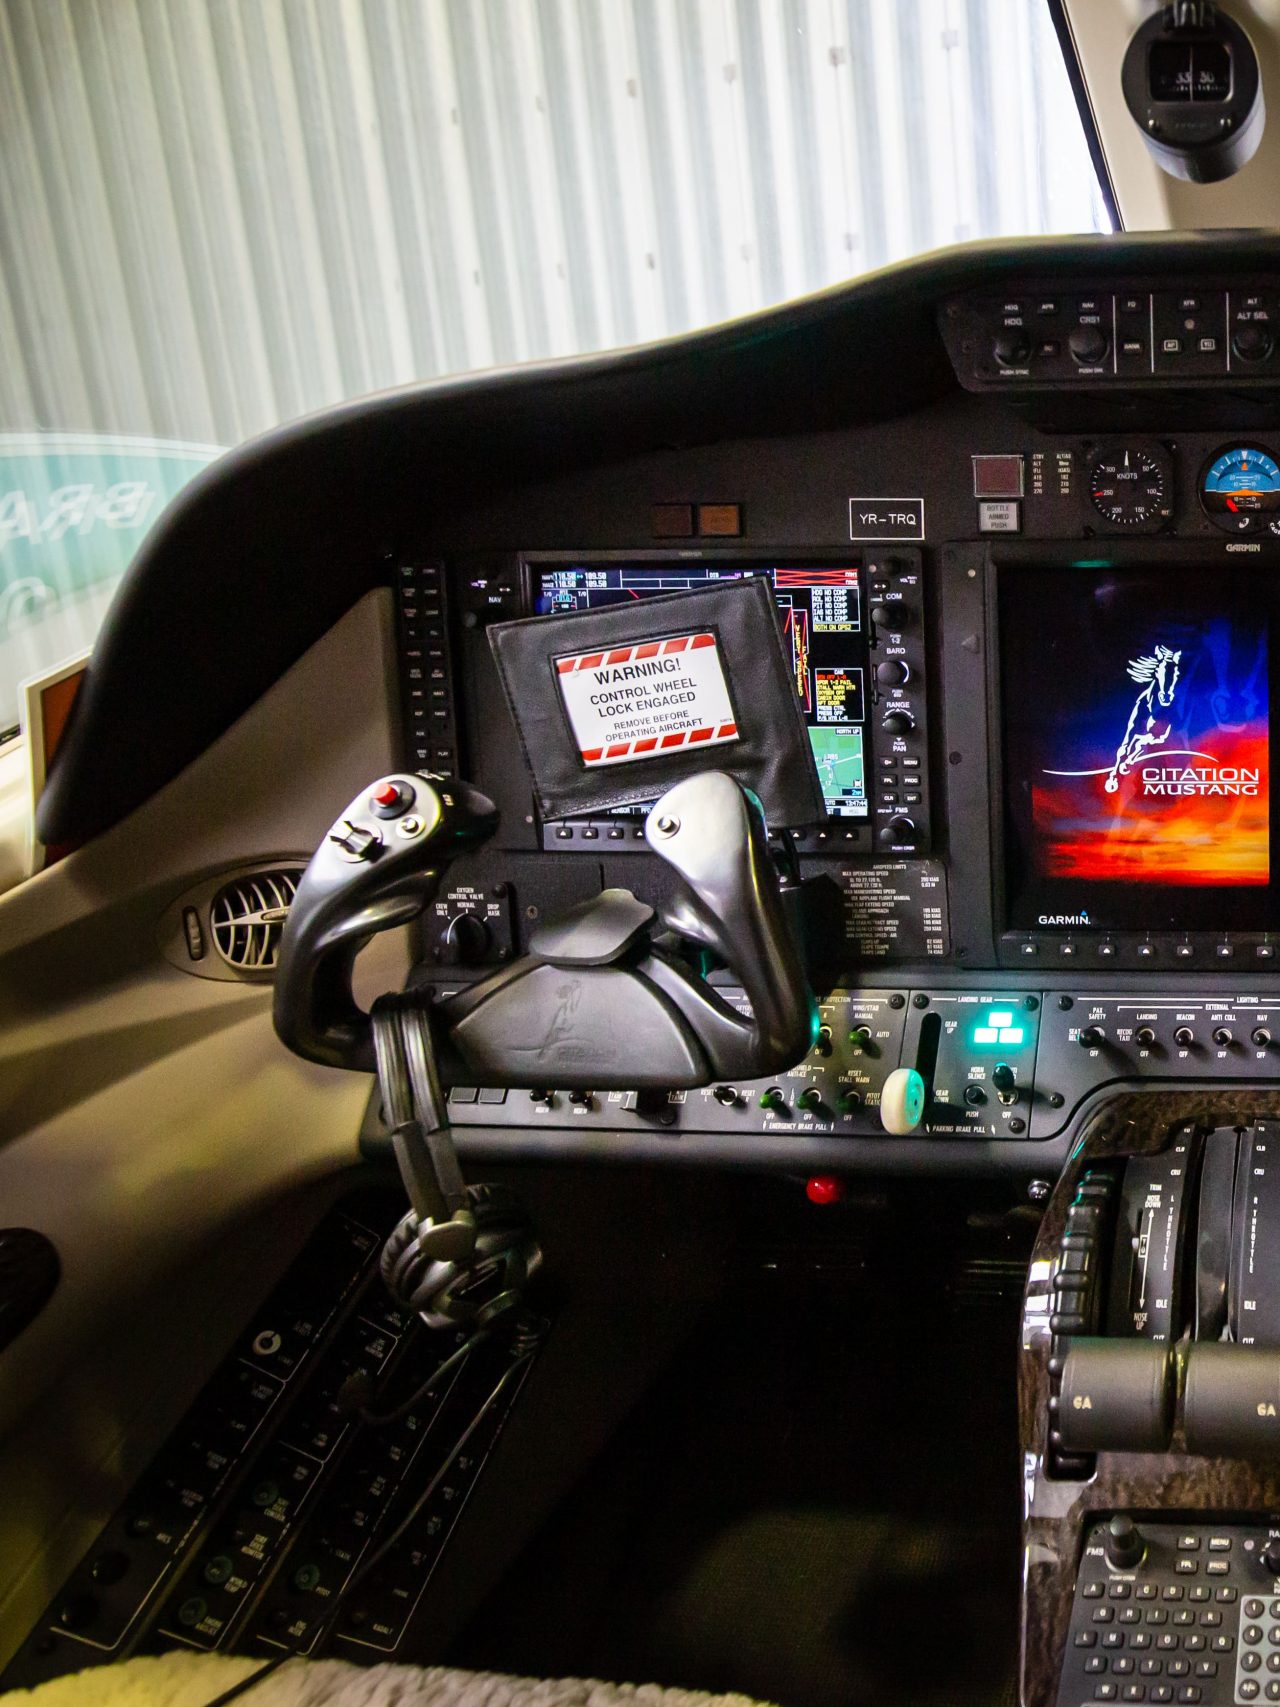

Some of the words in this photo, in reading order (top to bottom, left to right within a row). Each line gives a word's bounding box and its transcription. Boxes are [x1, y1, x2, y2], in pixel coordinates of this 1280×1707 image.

[1237, 312, 1251, 320] ALT
[1254, 312, 1268, 320] SEL
[860, 514, 916, 525] YR-TRQ
[1226, 544, 1261, 552] GARMIN
[594, 658, 680, 684] WARNING!
[590, 687, 651, 704] CONTROL
[653, 678, 697, 693] WHEEL
[598, 703, 633, 717] LOCK
[637, 692, 695, 710] ENGAGED
[614, 717, 651, 730] REMOVE
[653, 710, 689, 722] BEFORE
[606, 727, 656, 742] OPERATING
[659, 718, 702, 732] AIRCRAFT
[1142, 768, 1259, 781] CITATION
[1143, 784, 1258, 796] MUSTANG
[1038, 914, 1088, 925] GARMIN
[1156, 1300, 1168, 1308] IDLE
[1244, 1301, 1256, 1310] IDLE
[1073, 1396, 1091, 1409] GA
[1257, 1403, 1276, 1416] GA
[1086, 1547, 1104, 1556] FMS
